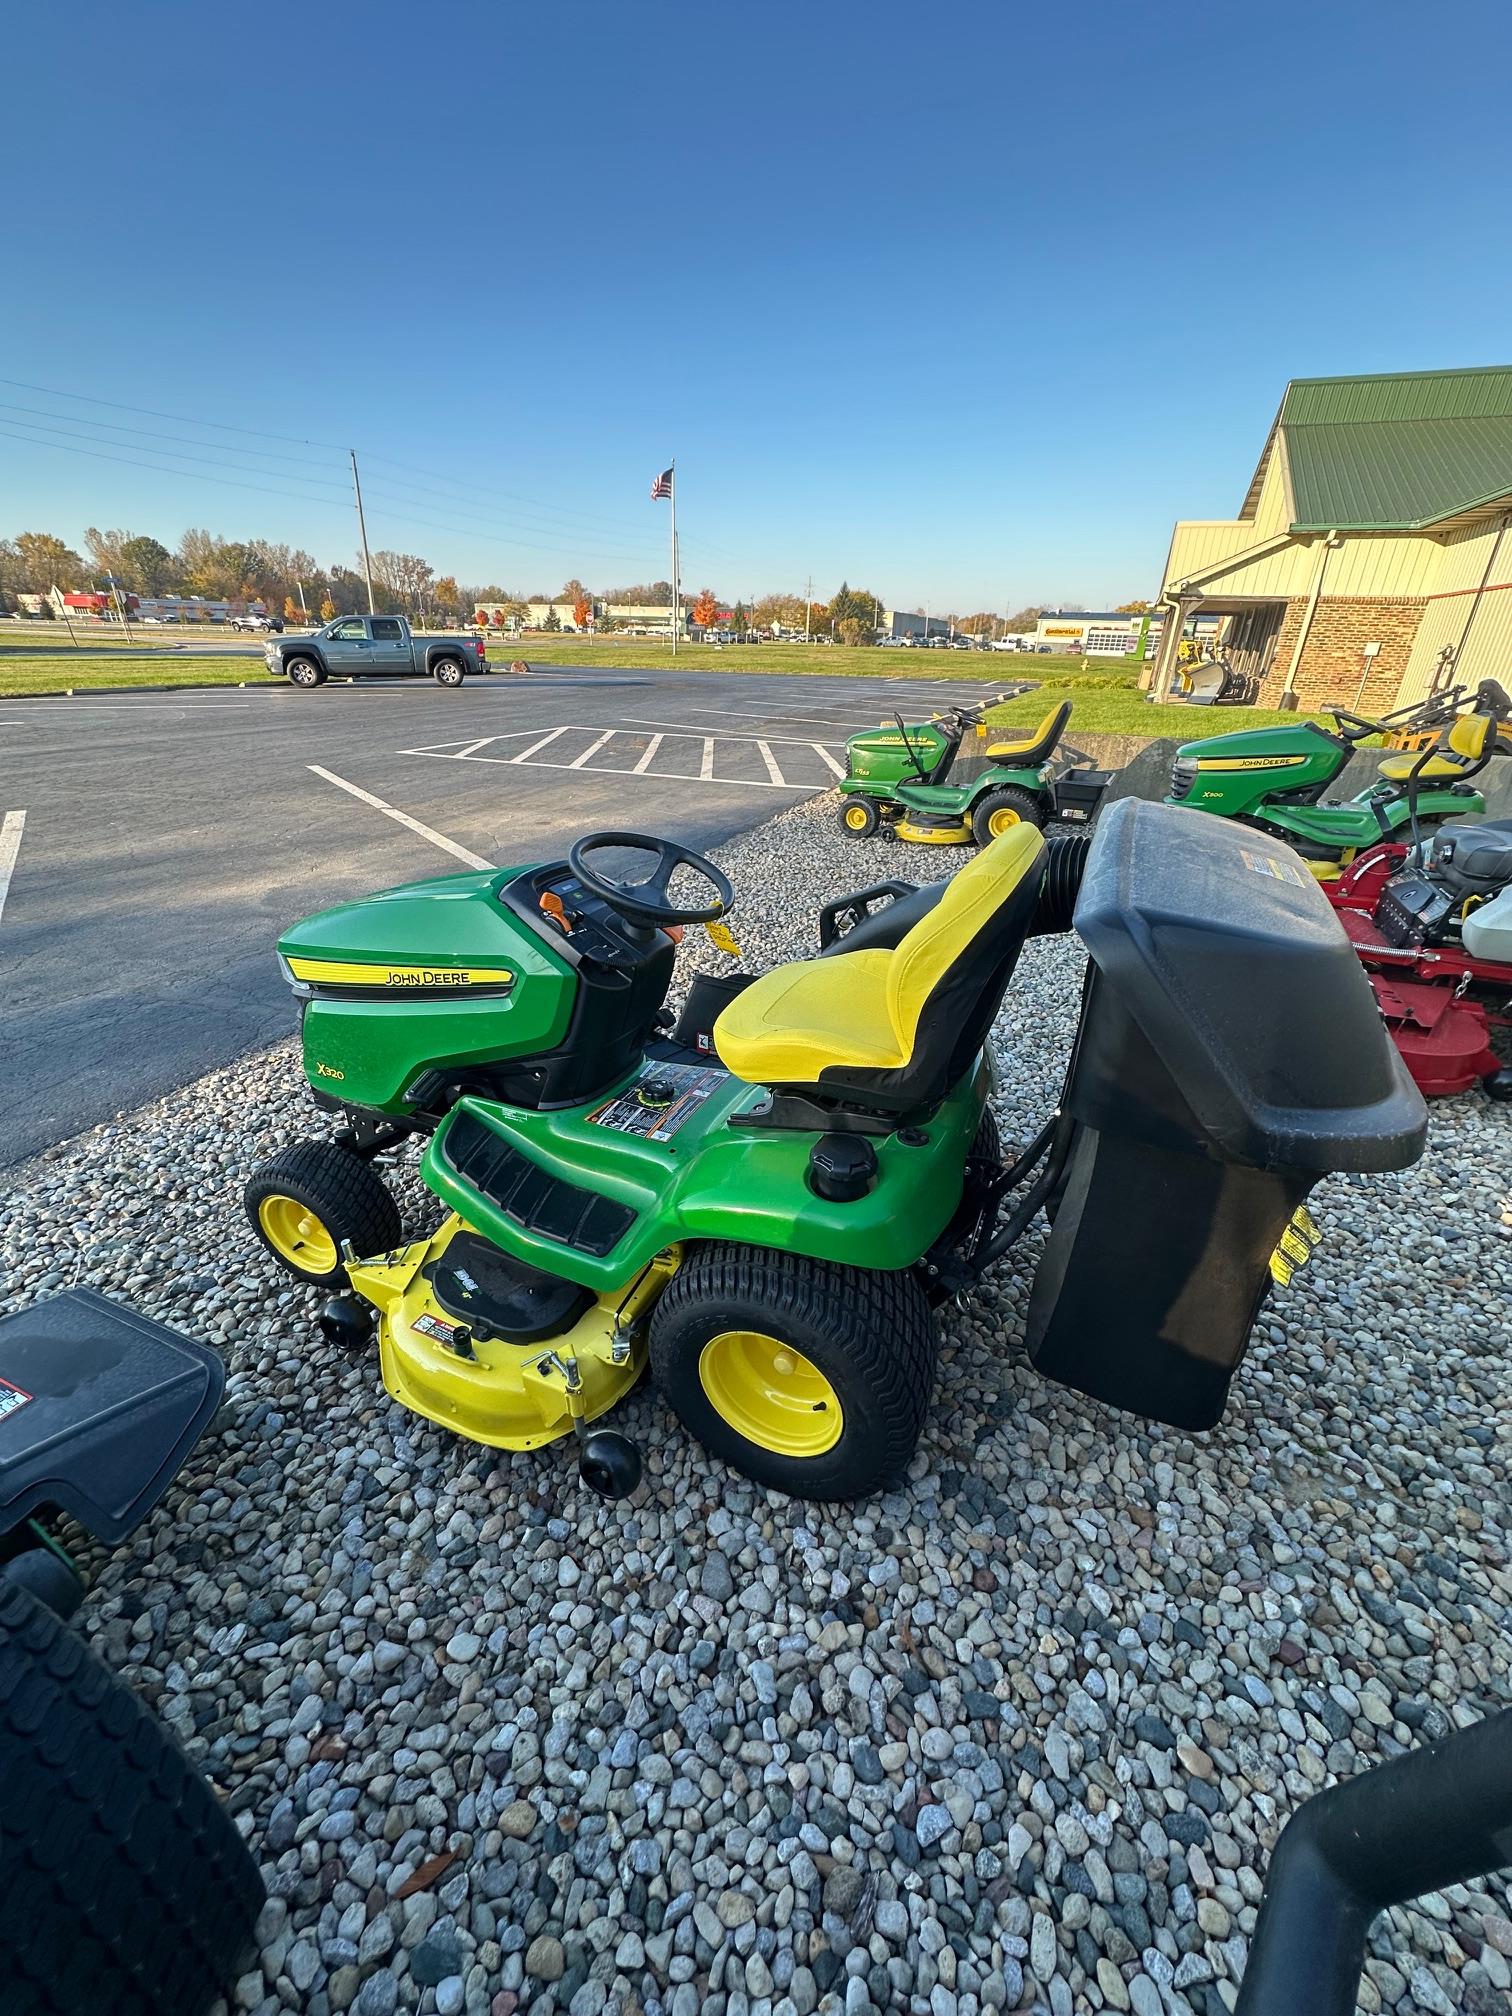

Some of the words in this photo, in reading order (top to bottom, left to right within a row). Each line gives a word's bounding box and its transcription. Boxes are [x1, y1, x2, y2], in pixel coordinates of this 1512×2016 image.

[386, 972, 420, 984] JOHN
[423, 972, 470, 984] DEERE
[316, 1062, 344, 1080] X320
